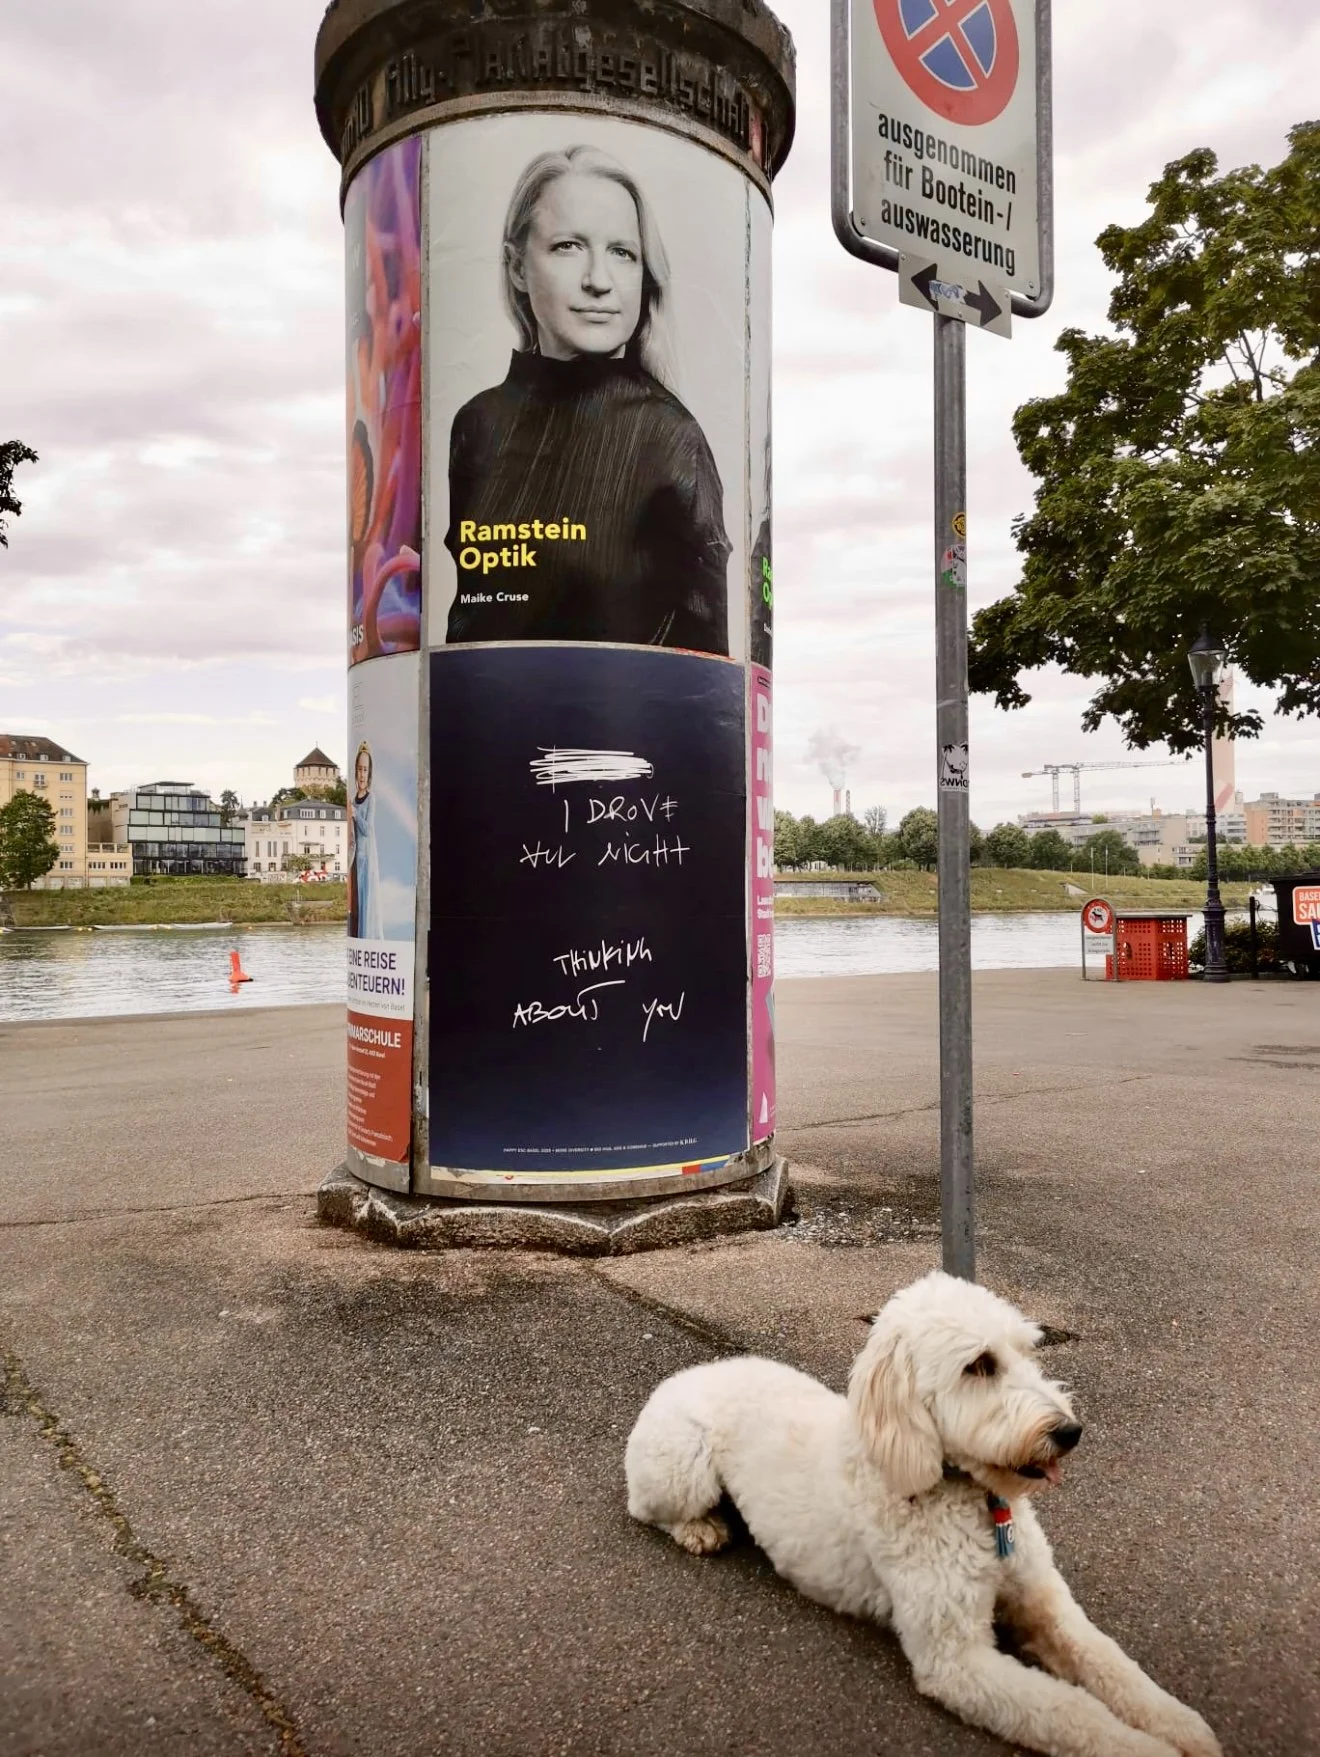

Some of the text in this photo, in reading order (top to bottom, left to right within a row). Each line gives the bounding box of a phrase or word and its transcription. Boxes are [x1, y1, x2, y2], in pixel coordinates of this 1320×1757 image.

[878, 113, 1016, 195] ausgenommen
[883, 150, 914, 191] für
[881, 199, 1015, 277] auswasserung
[460, 517, 587, 543] Ramstein
[459, 543, 537, 575] Optik
[460, 591, 530, 604] Maike Cruse
[587, 794, 679, 823] DROVE
[364, 950, 397, 970] REISE
